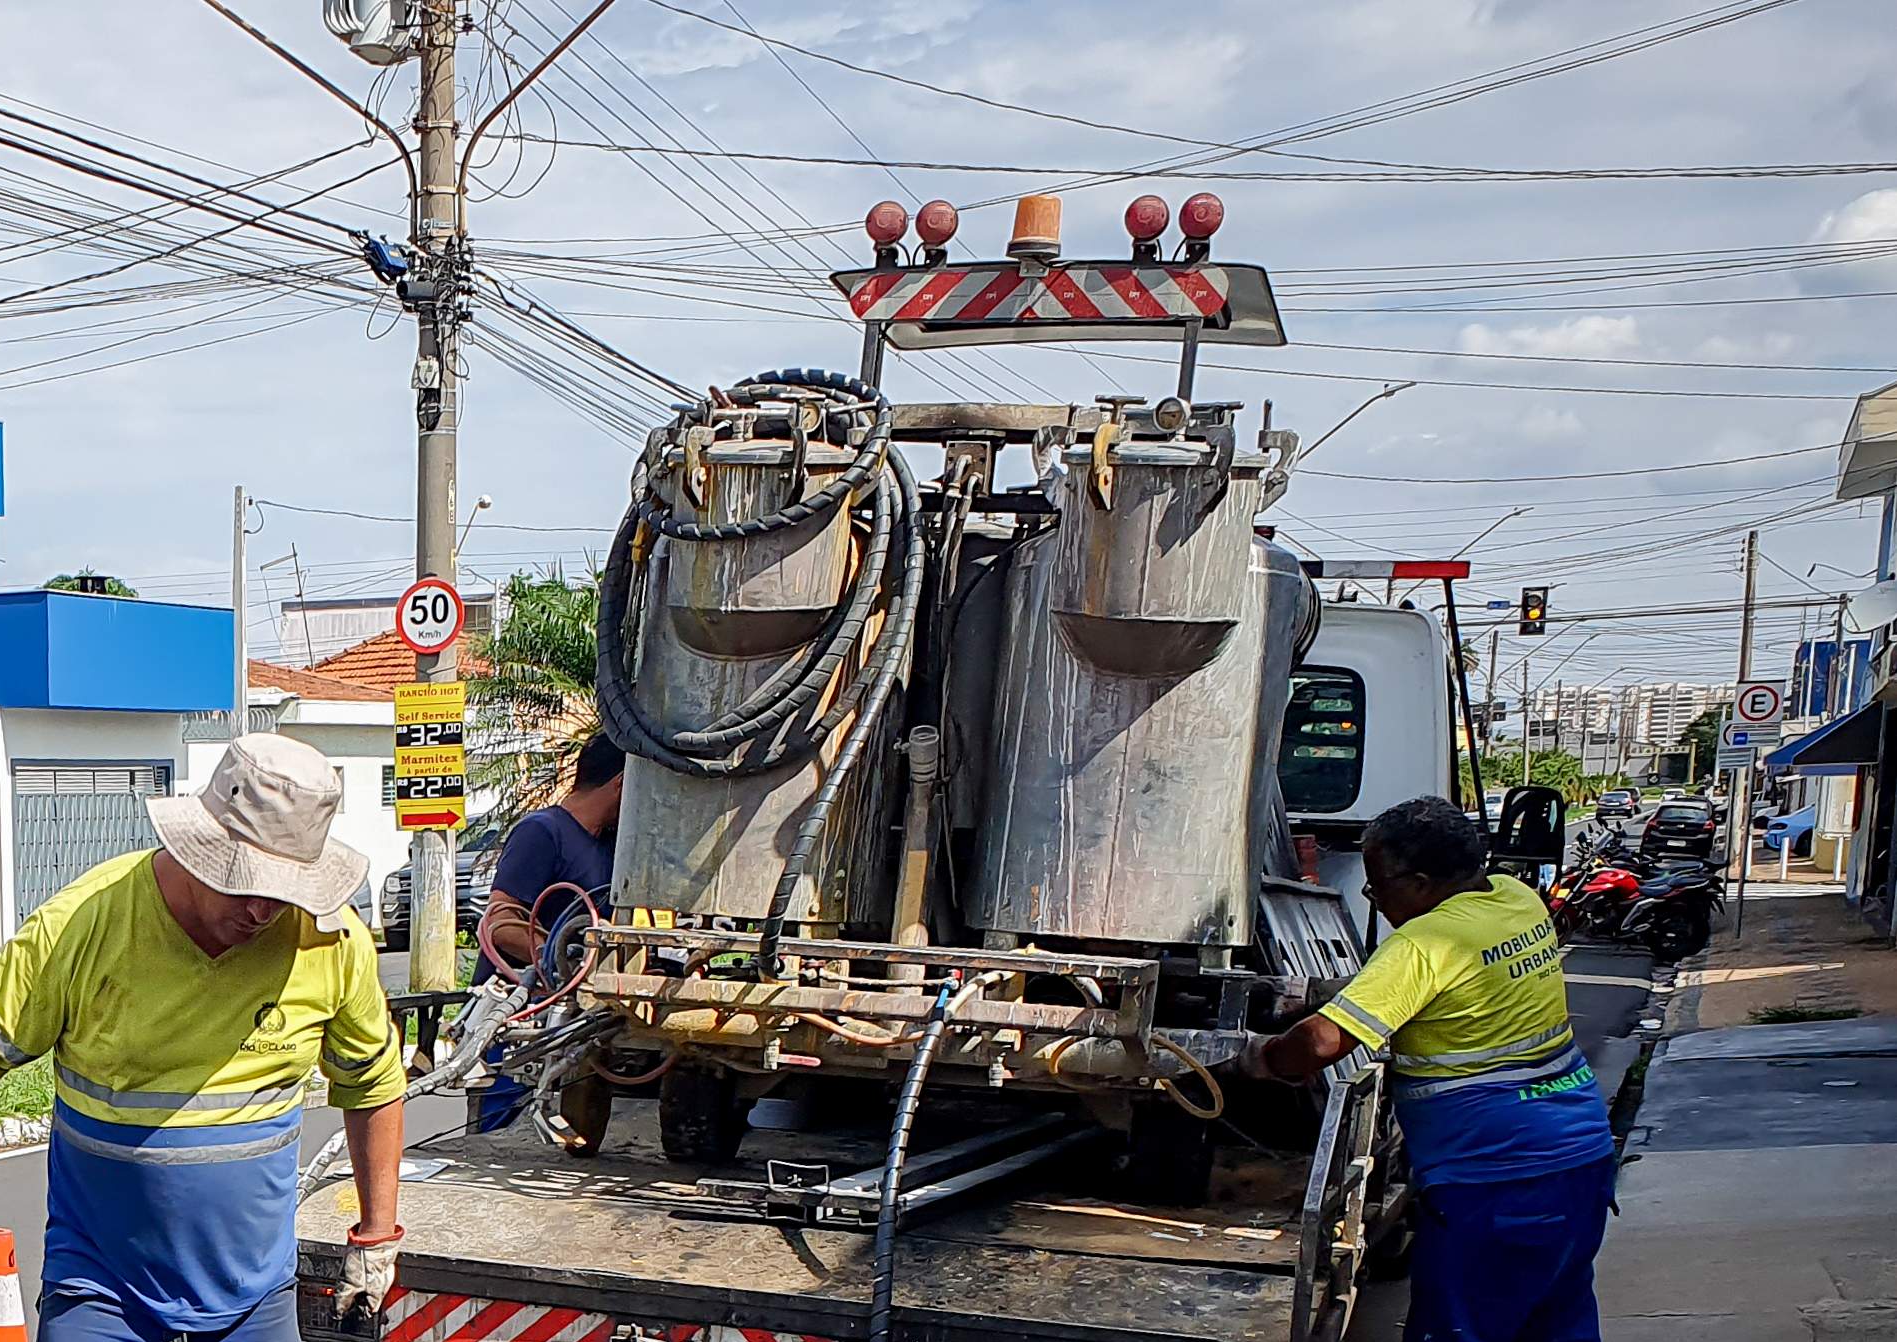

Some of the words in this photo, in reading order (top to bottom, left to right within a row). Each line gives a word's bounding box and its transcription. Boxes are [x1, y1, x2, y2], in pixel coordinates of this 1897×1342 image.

[410, 593, 449, 625] 50
[1750, 693, 1767, 713] E
[398, 712, 419, 721] Self
[422, 710, 461, 720] Service
[401, 754, 458, 765] Marmitex
[1508, 940, 1560, 980] URBAN
